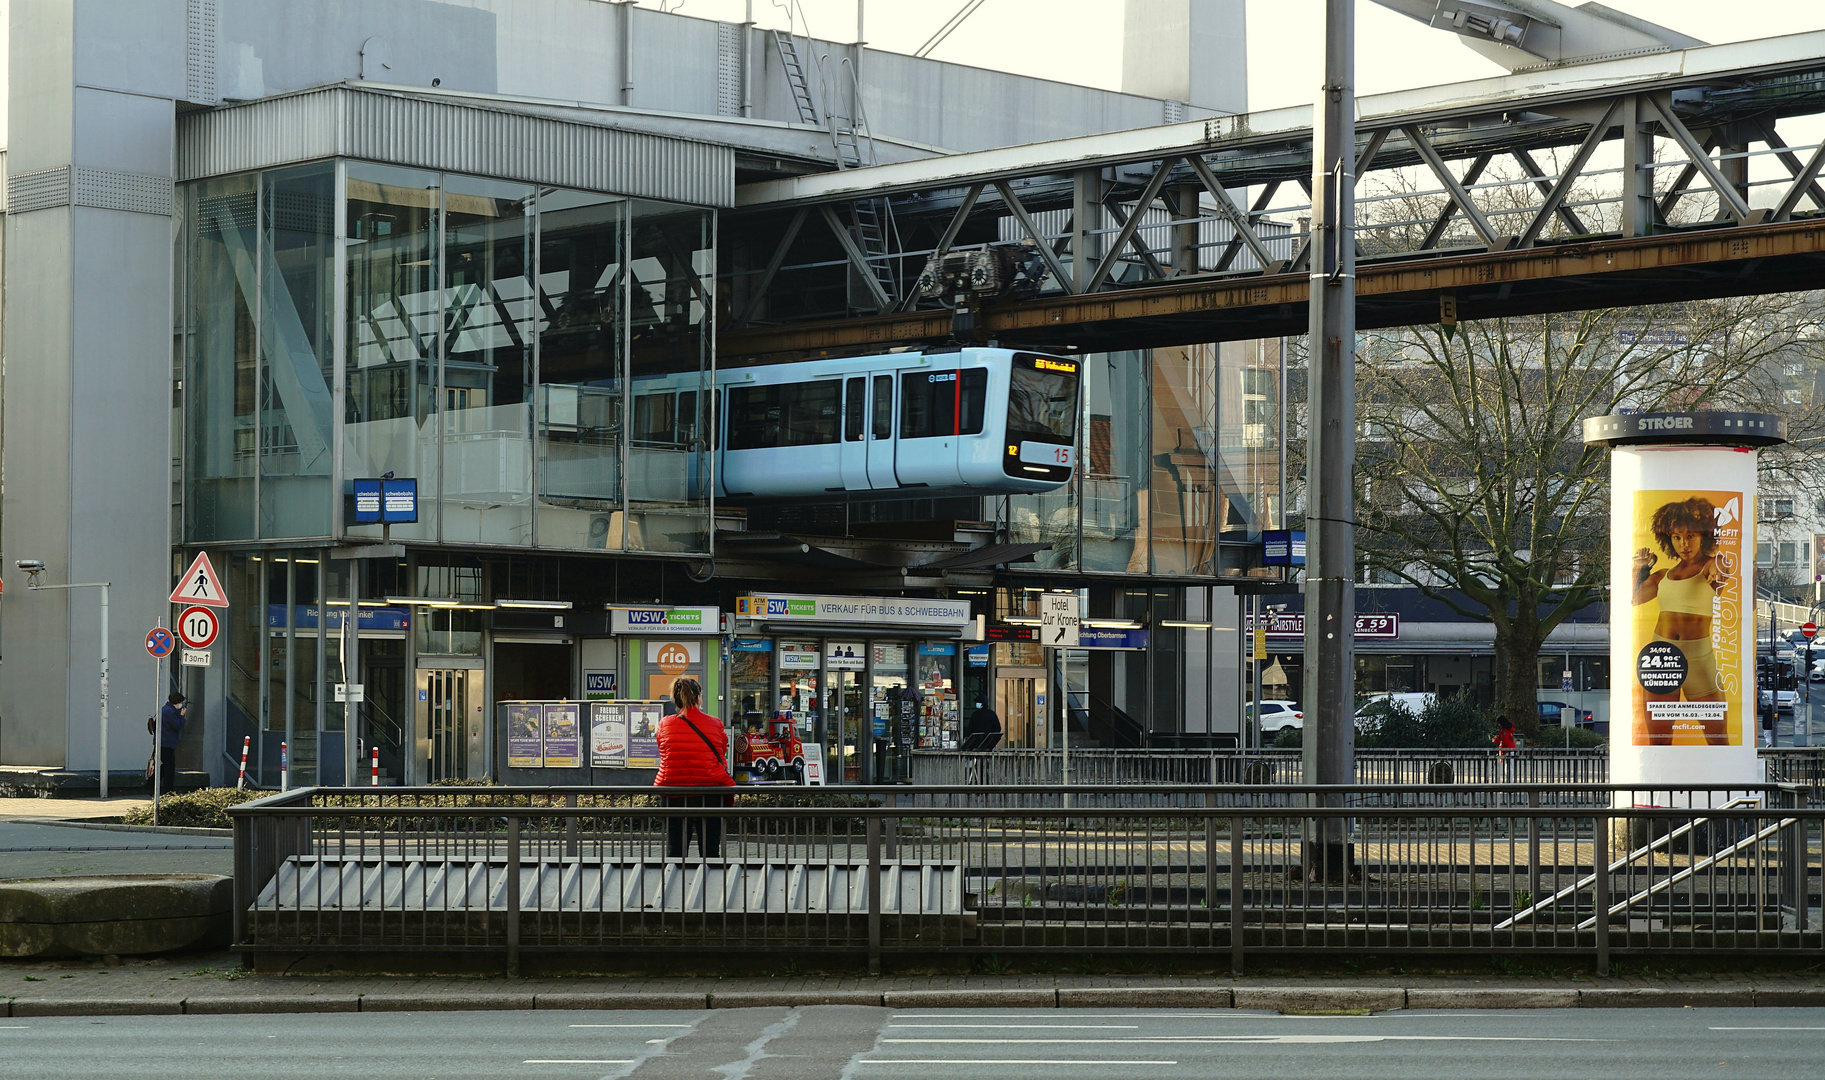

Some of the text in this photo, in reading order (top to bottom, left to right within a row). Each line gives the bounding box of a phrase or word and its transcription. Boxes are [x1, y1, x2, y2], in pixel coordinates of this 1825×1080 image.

[1444, 301, 1452, 317] E
[1638, 416, 1693, 431] STRÖER
[1054, 448, 1069, 463] 15
[1713, 529, 1738, 537] McFIT
[767, 601, 785, 613] SW
[821, 604, 859, 614] VERKAUF
[860, 604, 877, 615] FÜR
[879, 606, 895, 615] BUS
[898, 607, 903, 615] &
[905, 607, 964, 618] SCHWEBEBAHN
[1051, 597, 1069, 611] Hotel
[630, 611, 662, 622] WSW
[1043, 612, 1078, 627] Zur Krone
[1369, 619, 1388, 629] 59
[1712, 595, 1722, 649] FOREVER
[1715, 550, 1739, 696] STRONG
[189, 618, 208, 638] 10
[1079, 631, 1127, 640] ichtung Oberbarmen
[661, 647, 686, 664] ria
[588, 676, 612, 688] WSW
